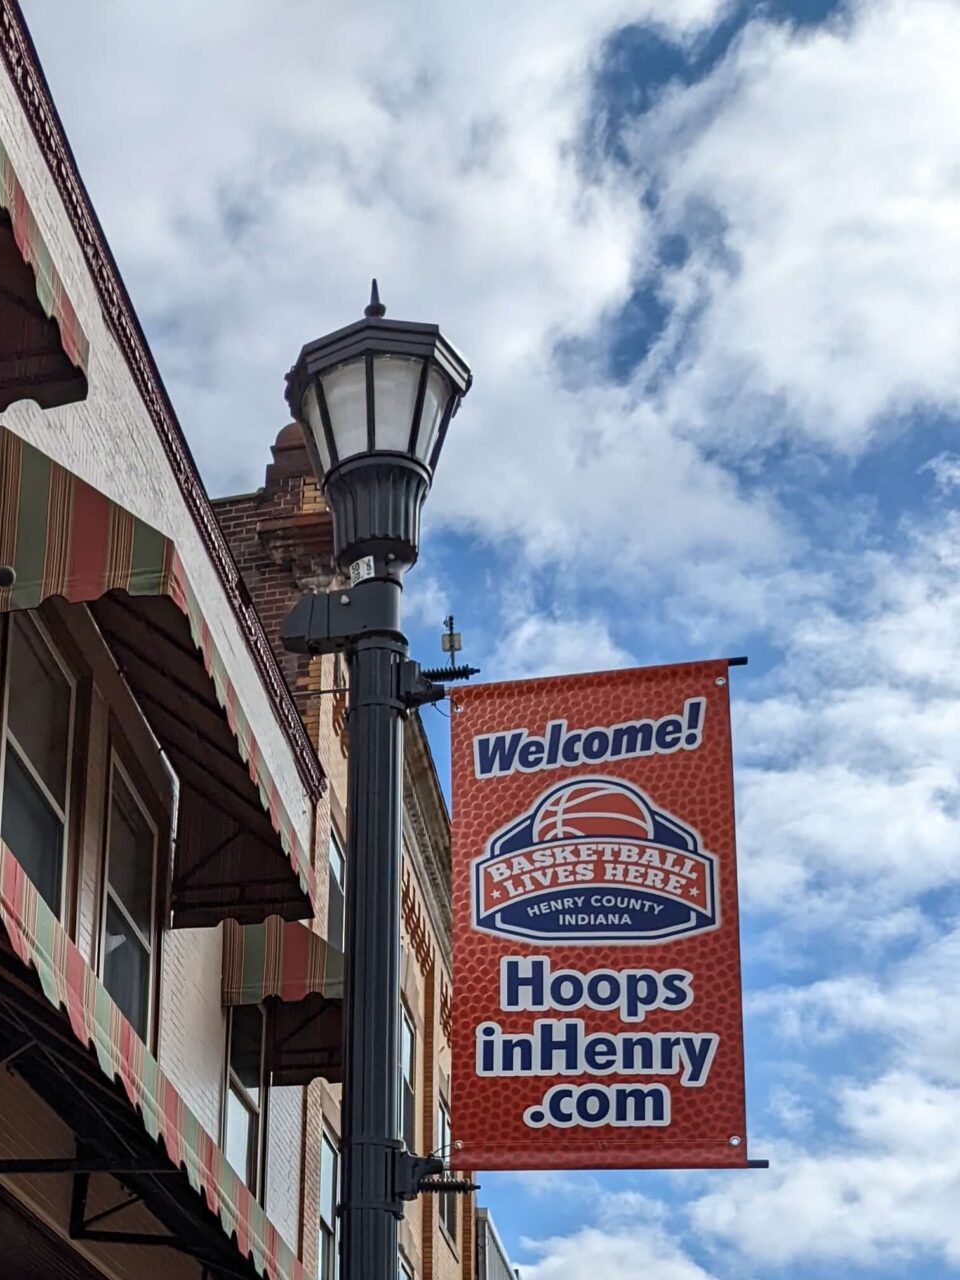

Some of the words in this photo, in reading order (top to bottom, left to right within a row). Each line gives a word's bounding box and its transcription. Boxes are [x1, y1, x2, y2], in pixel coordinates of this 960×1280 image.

[476, 699, 704, 777] Welcome!
[487, 843, 698, 883] BASKETBALL
[502, 863, 594, 898] LIVES
[604, 863, 687, 896] HERE
[527, 895, 585, 917] HENRY
[591, 895, 664, 916] COUNTY
[558, 913, 632, 926] INDIANA
[504, 958, 690, 1020] Hoops
[480, 1021, 715, 1084] inHenry
[527, 1086, 667, 1125] .com
